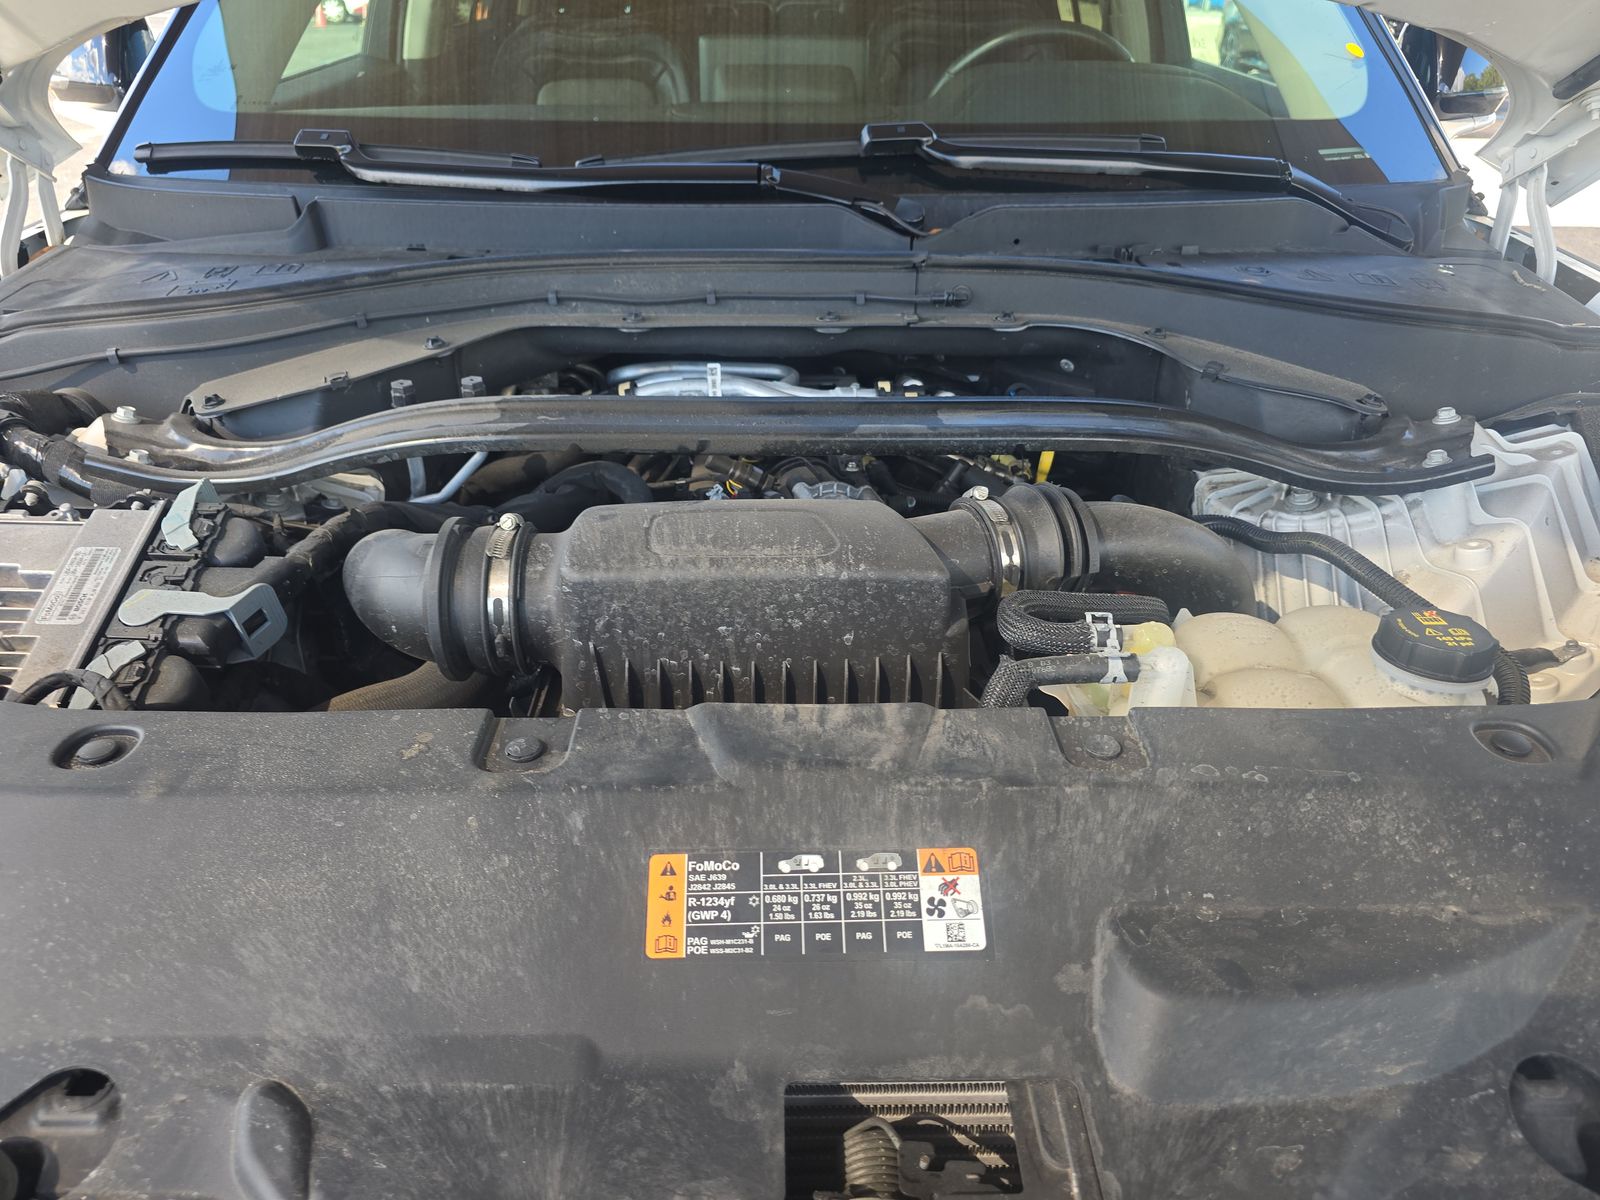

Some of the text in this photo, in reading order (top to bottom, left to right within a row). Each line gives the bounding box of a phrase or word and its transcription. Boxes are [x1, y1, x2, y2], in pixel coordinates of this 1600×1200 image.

[688, 860, 740, 871] FoMoCo
[764, 894, 799, 905] 0.680 kg
[804, 894, 838, 904] 0.737 kg
[846, 892, 880, 902] 0.992 kg
[885, 892, 919, 902] 0.992 kg
[688, 896, 736, 908] R-1234yf
[893, 901, 903, 909] 35
[772, 904, 781, 912] 24
[811, 903, 821, 911] 26
[688, 910, 731, 922] (GWP 4)
[768, 912, 796, 920] 1.50 lbs
[850, 910, 878, 918] 2.19 lbs
[889, 910, 905, 918] 2.19
[774, 934, 791, 942] PAG
[815, 933, 832, 941] POE
[855, 932, 873, 940] PAG
[896, 931, 913, 939] POE
[687, 937, 709, 946] PAG
[687, 945, 709, 954] POE
